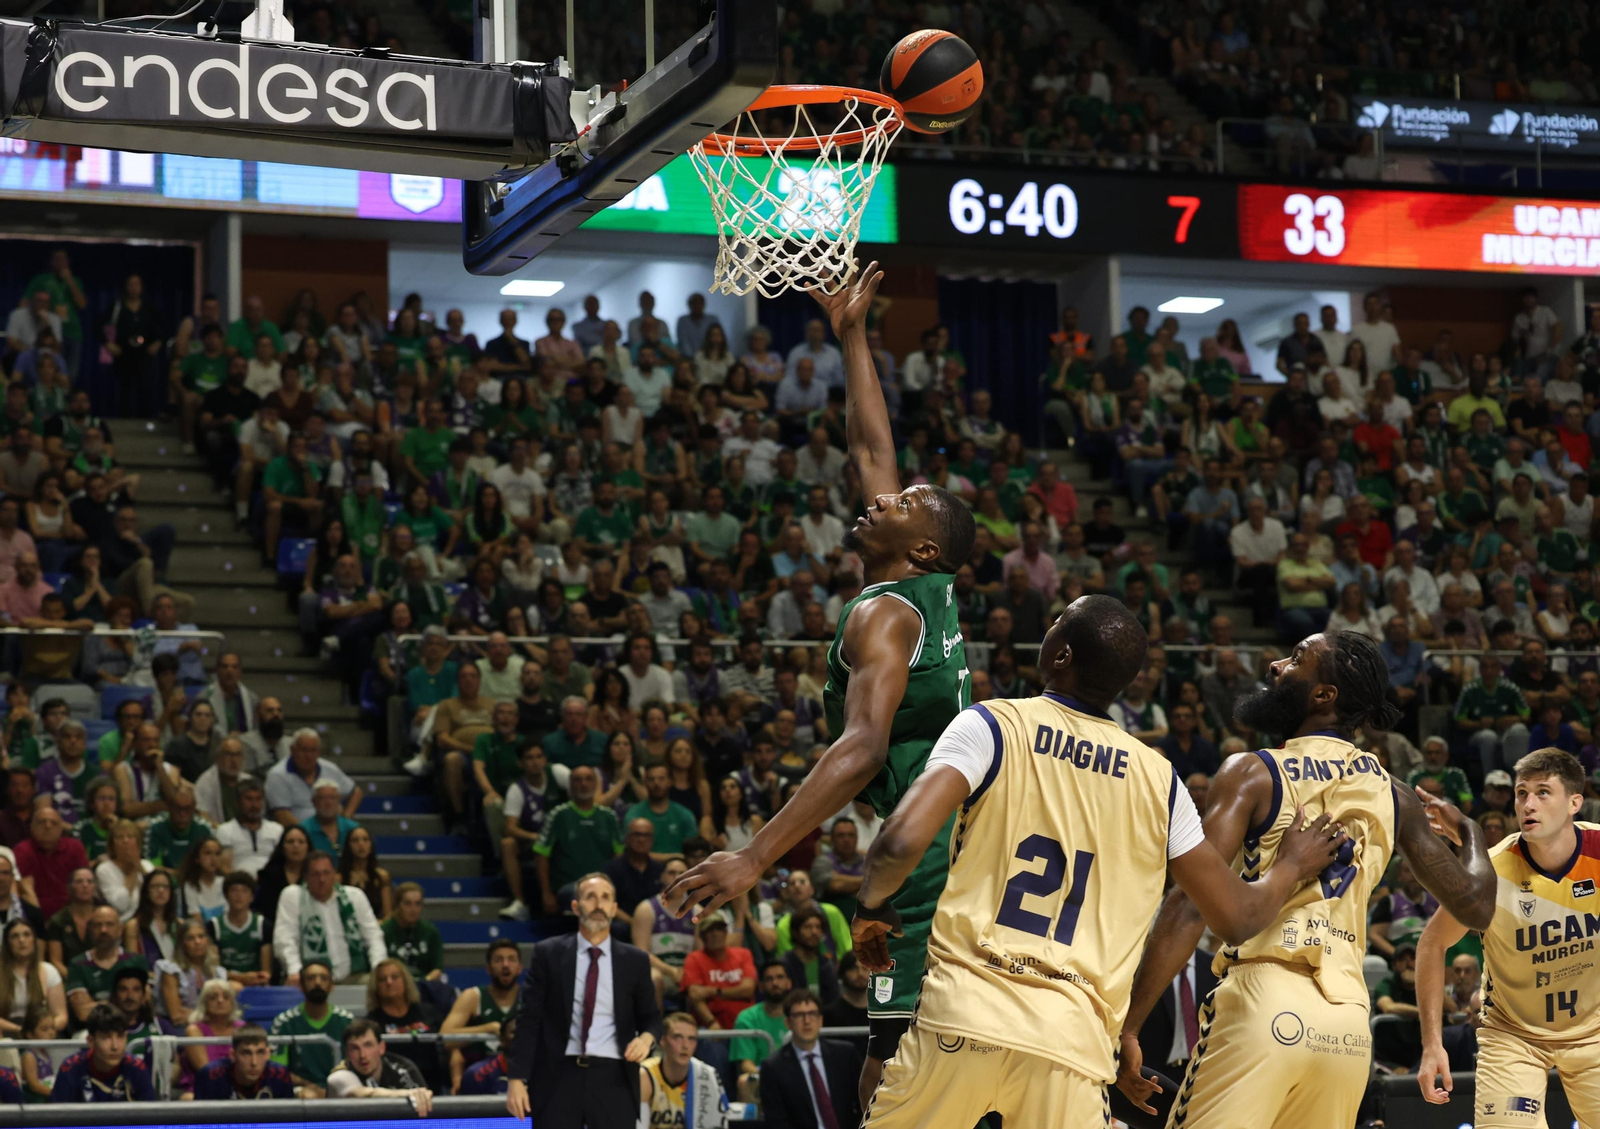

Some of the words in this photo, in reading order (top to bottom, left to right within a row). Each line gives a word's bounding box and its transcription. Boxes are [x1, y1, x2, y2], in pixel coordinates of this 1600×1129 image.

[54, 44, 437, 131] endesa
[1391, 103, 1470, 124] Fundación
[1522, 111, 1599, 132] Fundación
[949, 178, 1078, 239] 6:40
[1167, 195, 1201, 243] 7
[1283, 193, 1346, 257] 33
[1033, 724, 1129, 780] DIAGNE
[995, 833, 1095, 947] 21
[1532, 940, 1595, 965] MURCIA
[1008, 961, 1025, 975] de
[1546, 990, 1578, 1022] 14
[969, 1043, 1003, 1055] Región
[1304, 1040, 1330, 1054] Región
[1331, 1046, 1343, 1055] de
[1306, 1026, 1339, 1045] Costa
